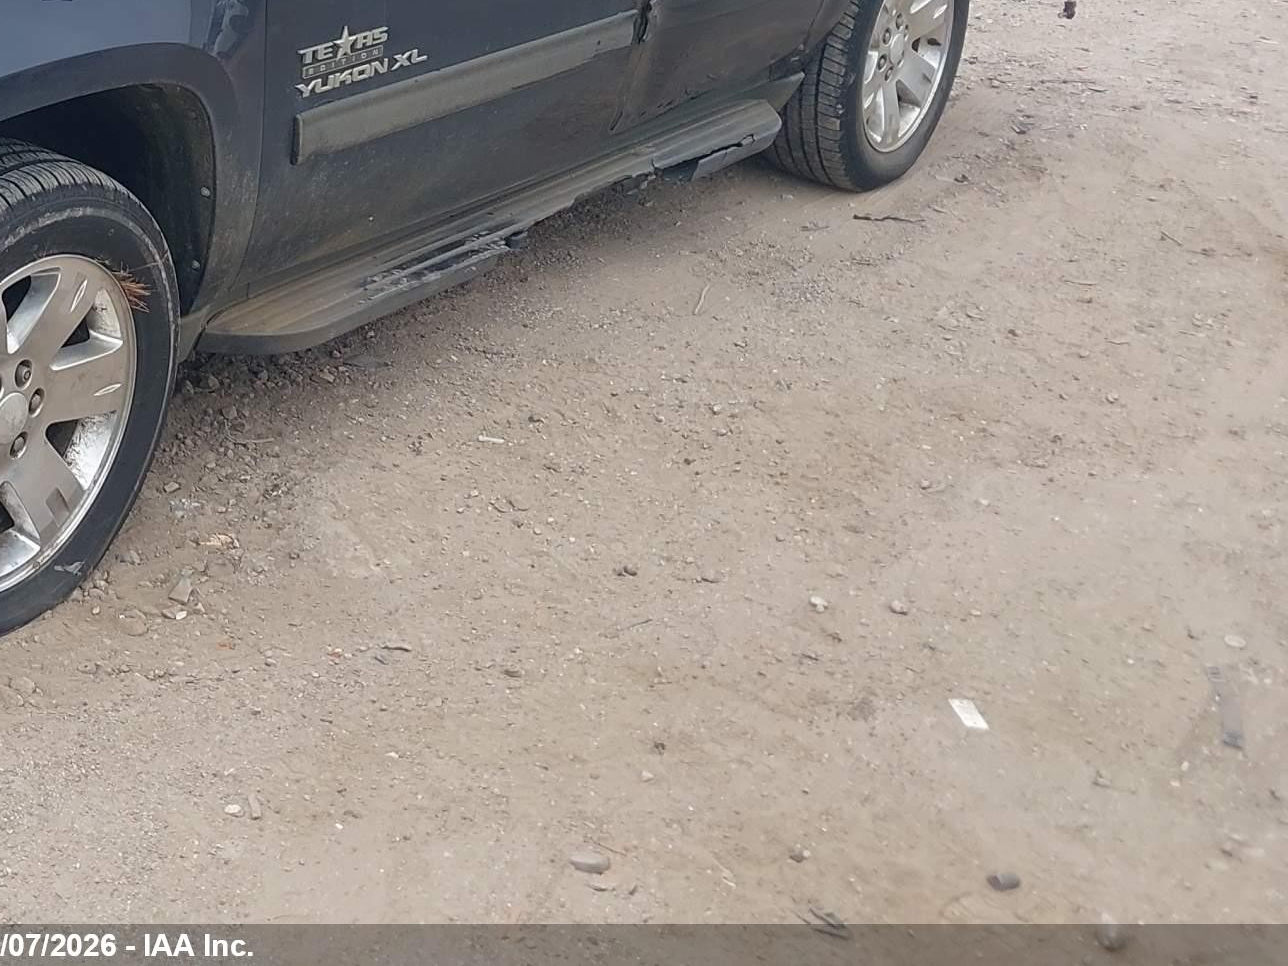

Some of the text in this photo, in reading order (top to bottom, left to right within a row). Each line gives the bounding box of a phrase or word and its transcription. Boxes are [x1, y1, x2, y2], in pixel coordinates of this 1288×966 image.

[298, 26, 389, 64] TEXAS
[306, 47, 381, 76] EDITION
[295, 48, 428, 98] YUKON XL
